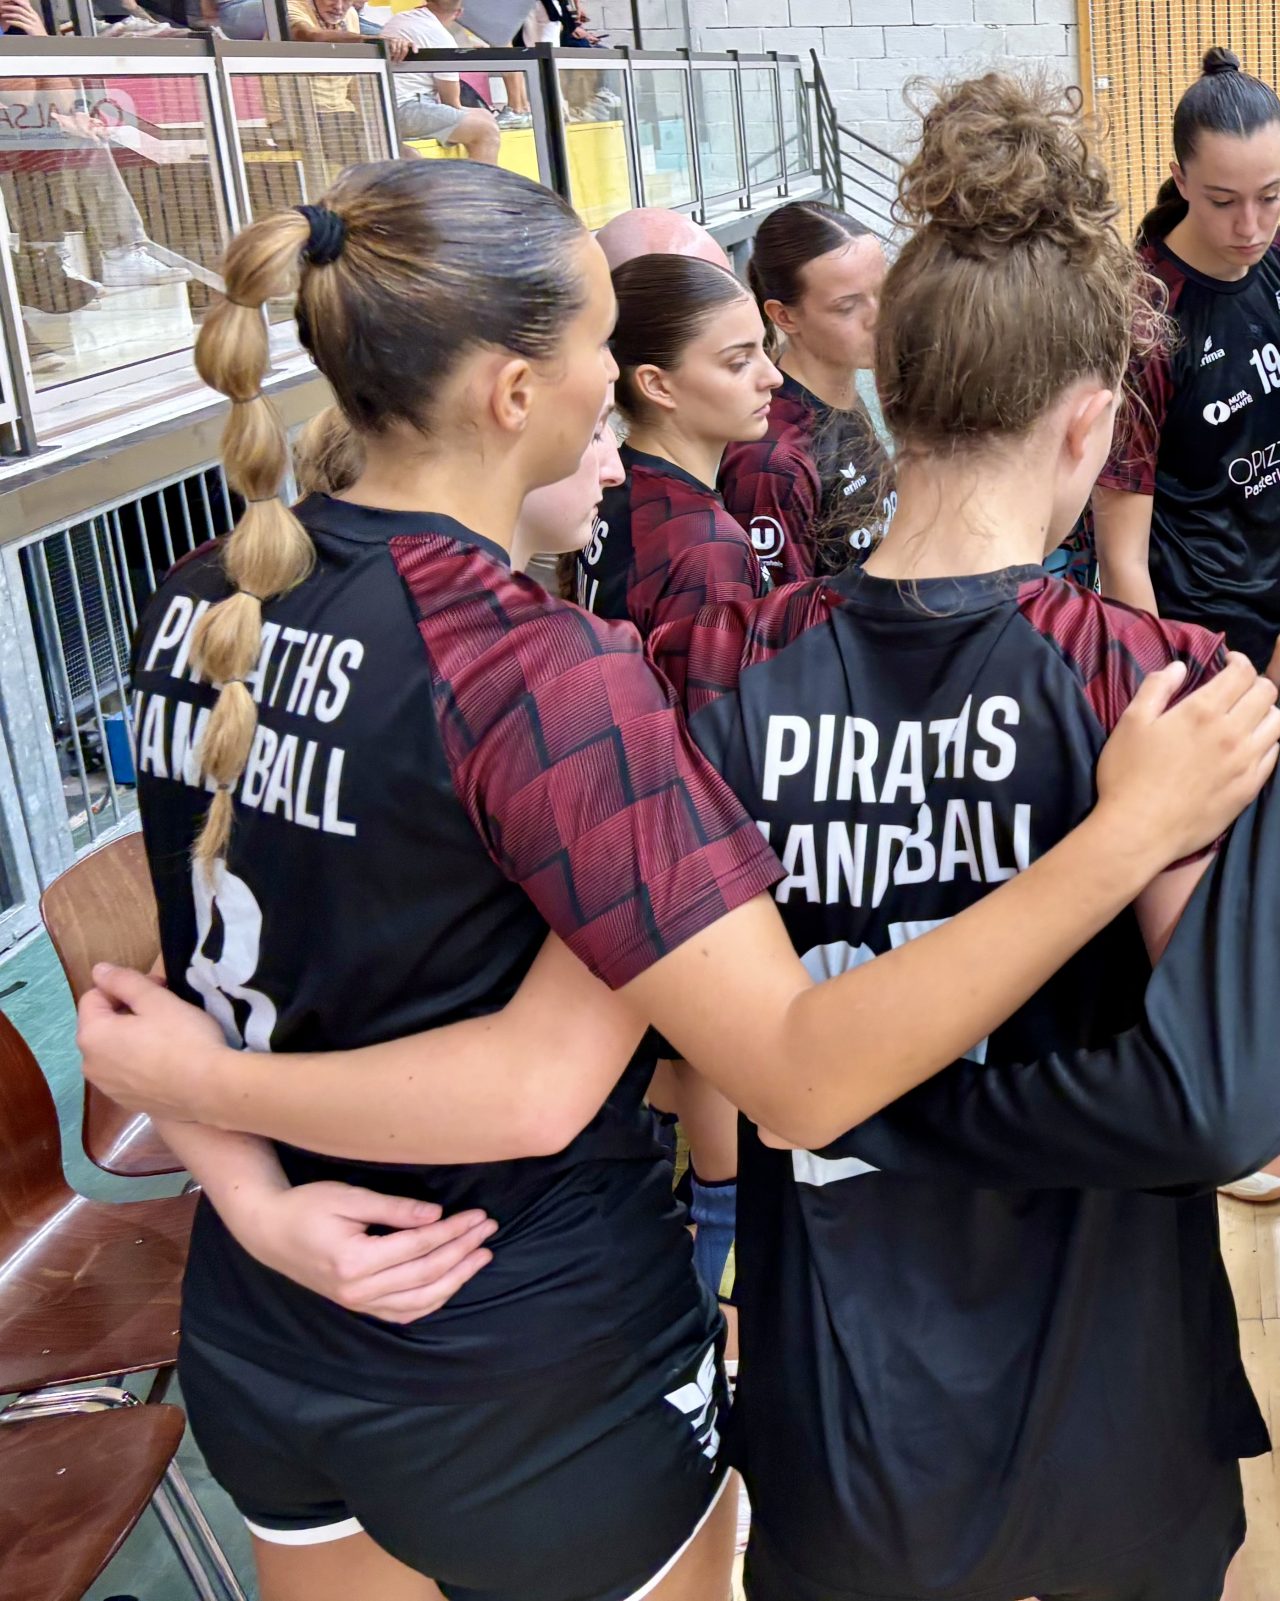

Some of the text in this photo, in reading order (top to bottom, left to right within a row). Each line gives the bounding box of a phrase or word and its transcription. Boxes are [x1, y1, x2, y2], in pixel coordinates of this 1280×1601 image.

[1200, 348, 1226, 368] rima
[843, 474, 867, 496] erima
[145, 595, 364, 723] PIATHS
[133, 688, 357, 836] ANBALL
[756, 799, 1032, 909] ANDBALL
